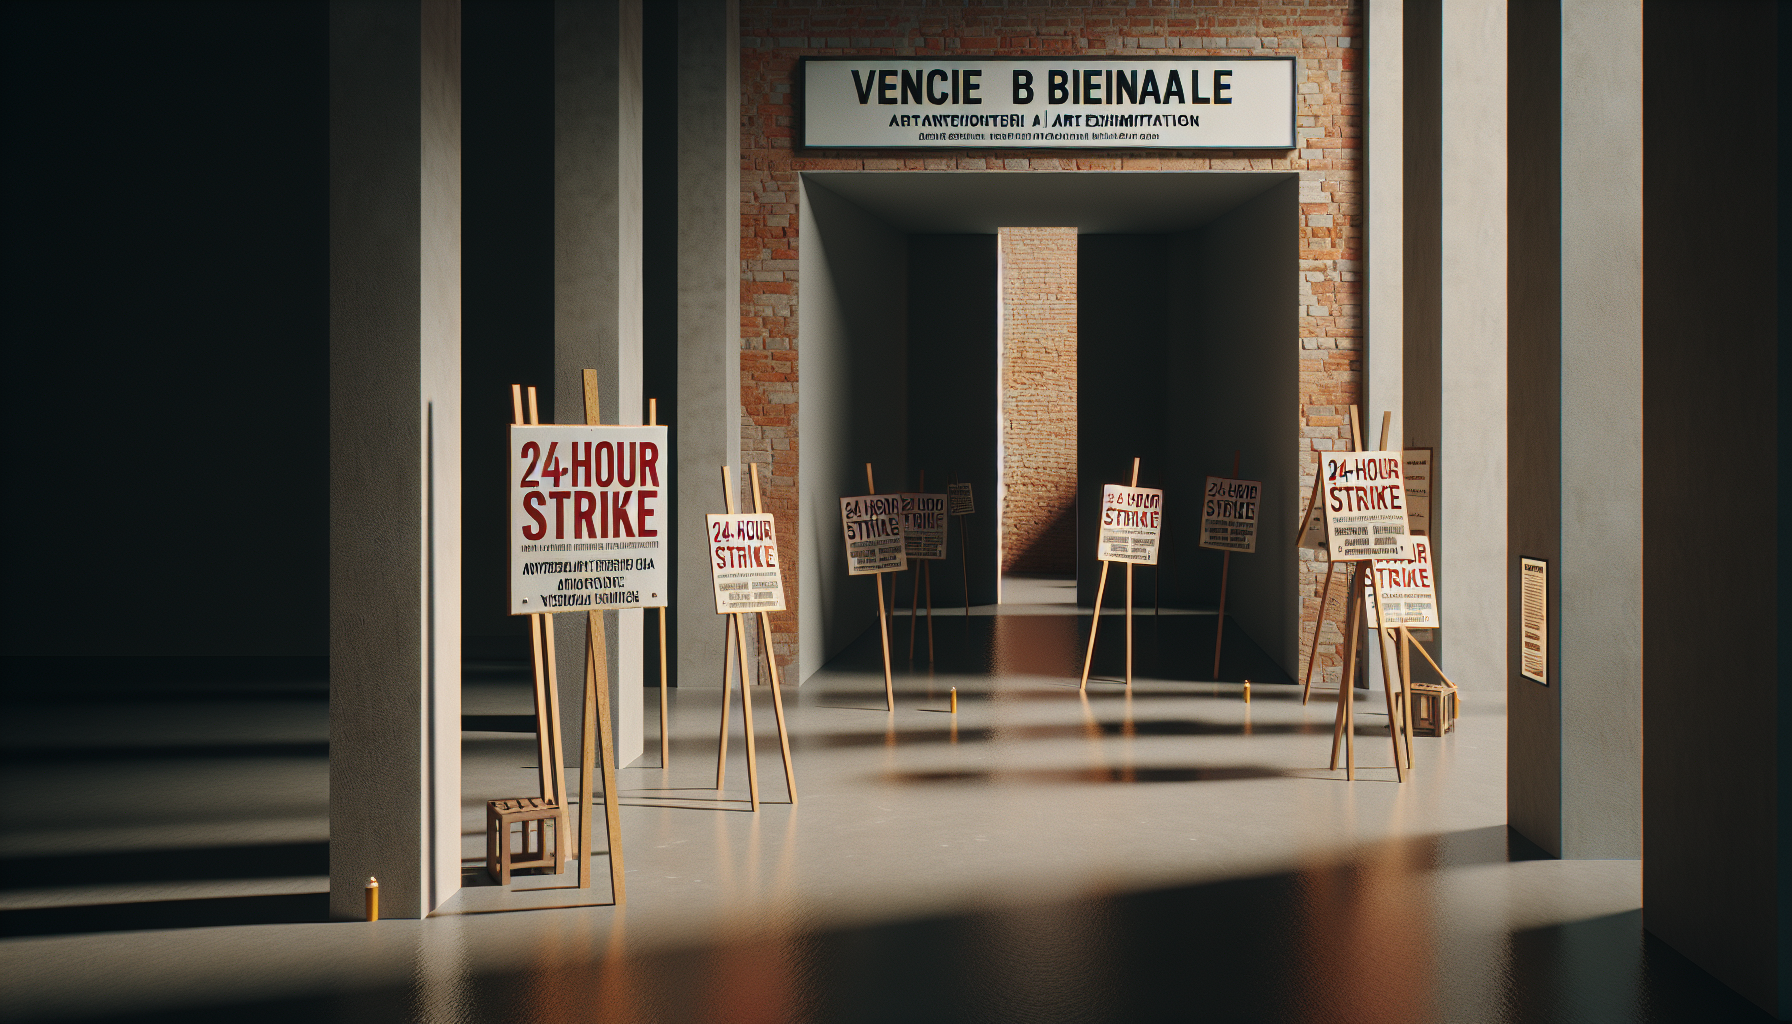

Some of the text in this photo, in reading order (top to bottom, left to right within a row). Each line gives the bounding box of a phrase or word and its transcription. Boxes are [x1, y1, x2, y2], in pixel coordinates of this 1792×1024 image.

[851, 69, 982, 105] VENCIE
[1012, 69, 1034, 105] B
[520, 440, 660, 488] 24-HOUR
[521, 490, 658, 541] STRIKE
[1329, 484, 1402, 512] STRIKE
